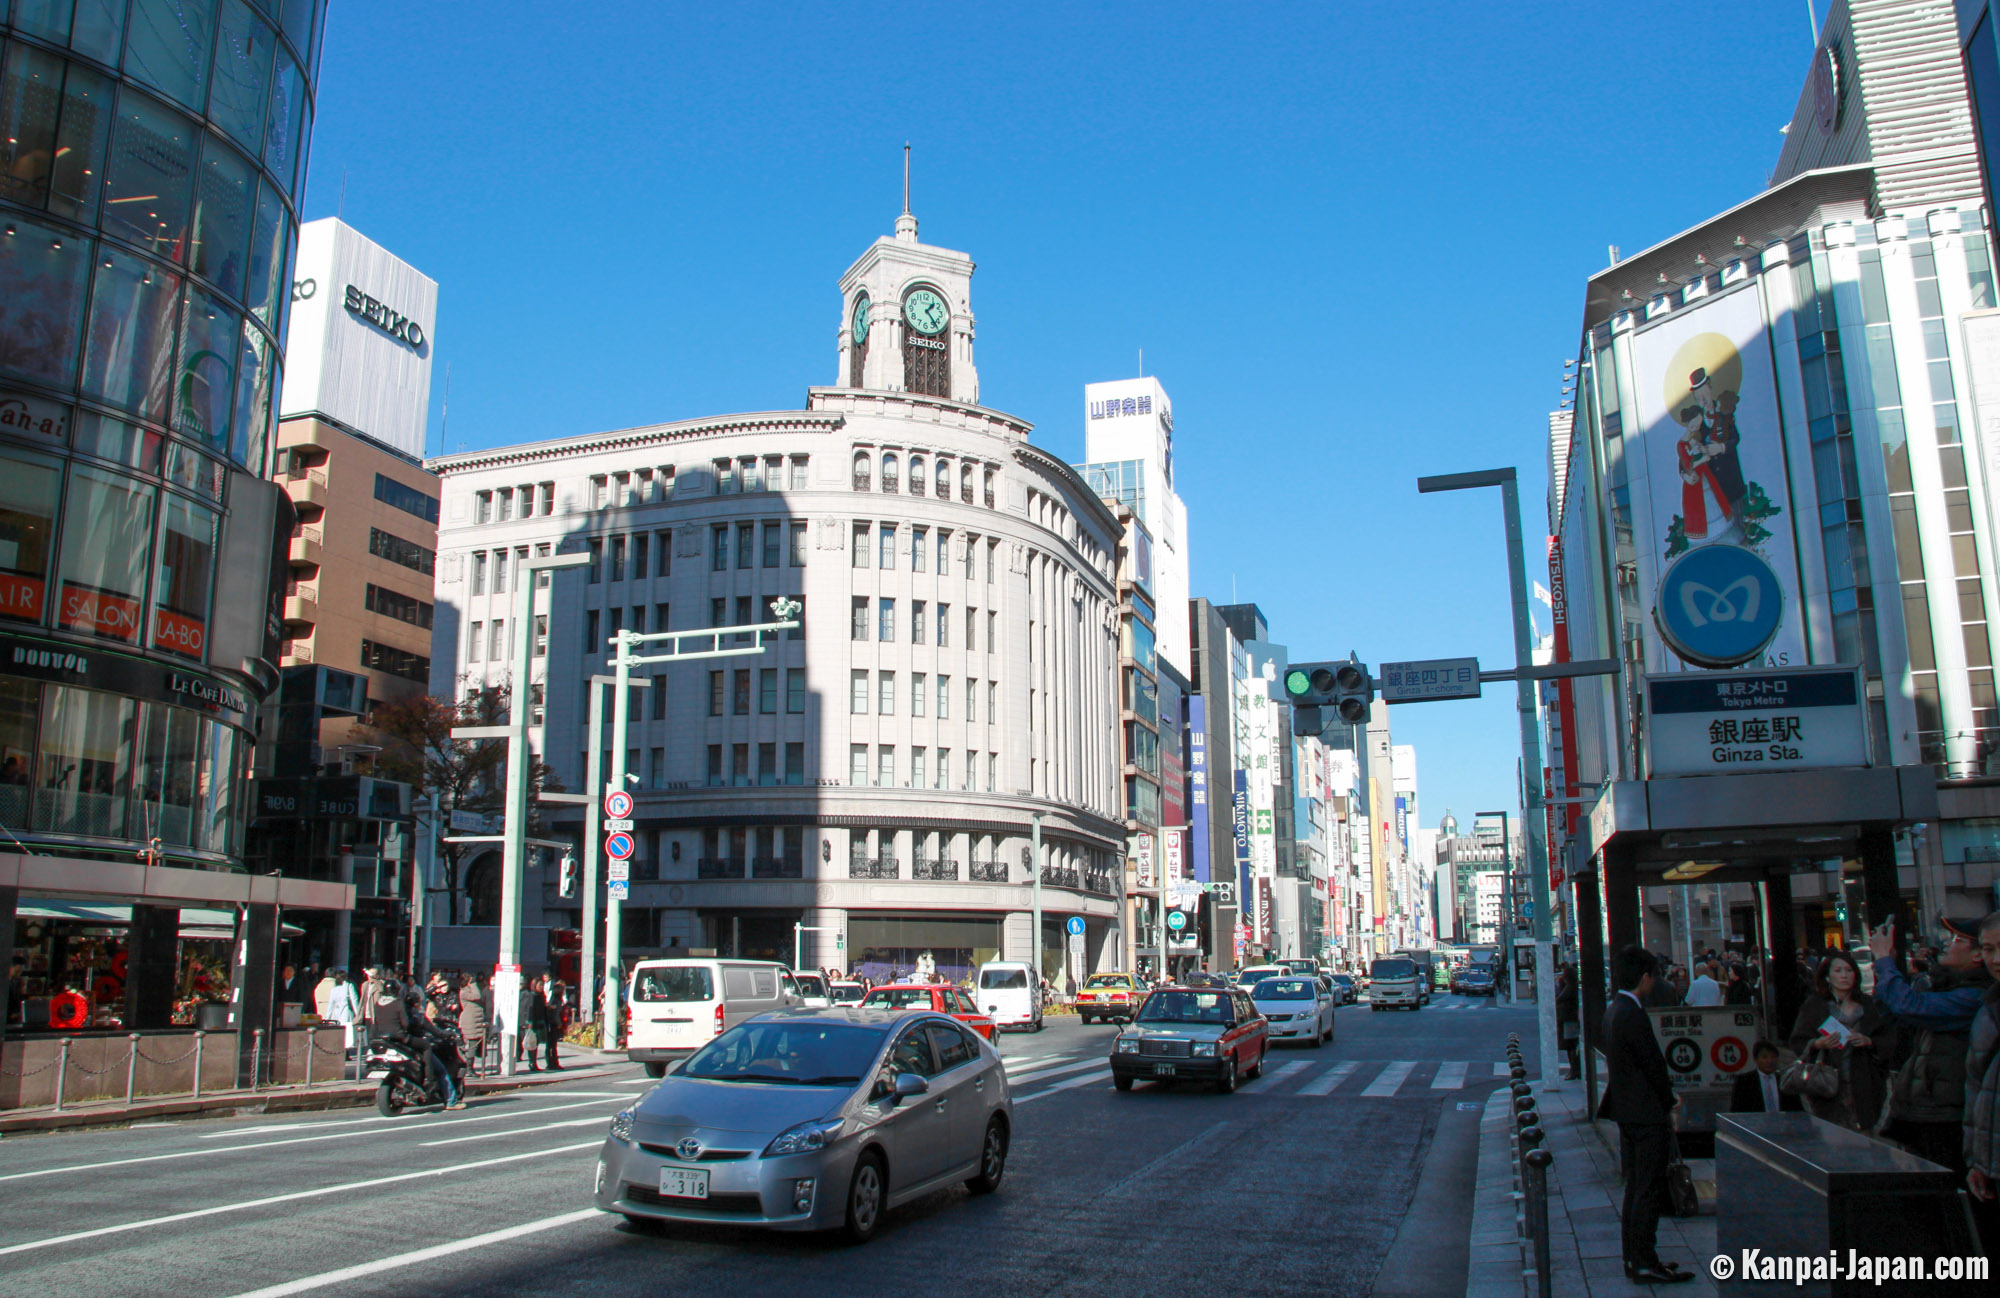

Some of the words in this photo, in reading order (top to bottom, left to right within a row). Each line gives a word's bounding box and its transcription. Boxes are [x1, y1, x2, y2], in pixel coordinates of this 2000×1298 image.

[344, 284, 423, 348] SEIKO
[908, 336, 945, 350] SEIKO
[1090, 396, 1152, 420] 山野楽器
[1548, 542, 1565, 624] MITSUKOSHI
[66, 597, 136, 629] SALON
[157, 617, 202, 649] LA-BO
[14, 647, 87, 673] DOUTOR
[1387, 667, 1472, 687] 銀座四丁目
[1396, 686, 1420, 695] Ginza
[1716, 680, 1788, 696] 東京メトロ
[1721, 697, 1751, 708] Tokyo
[1753, 695, 1785, 705] Metro
[1253, 694, 1268, 769] 教文館
[1709, 716, 1803, 744] 銀座駅
[1712, 747, 1763, 763] Ginza
[1769, 745, 1803, 761] Sta.
[1191, 732, 1206, 804] 山野楽器
[1236, 791, 1247, 847] MIKIMOTO
[1260, 813, 1271, 831] 本
[1261, 900, 1271, 936] ヨシノヤ
[1736, 1014, 1754, 1026] A3
[1679, 1044, 1688, 1054] H
[1723, 1045, 1735, 1053] M
[1723, 1054, 1737, 1063] 16
[1676, 1055, 1691, 1064] 08
